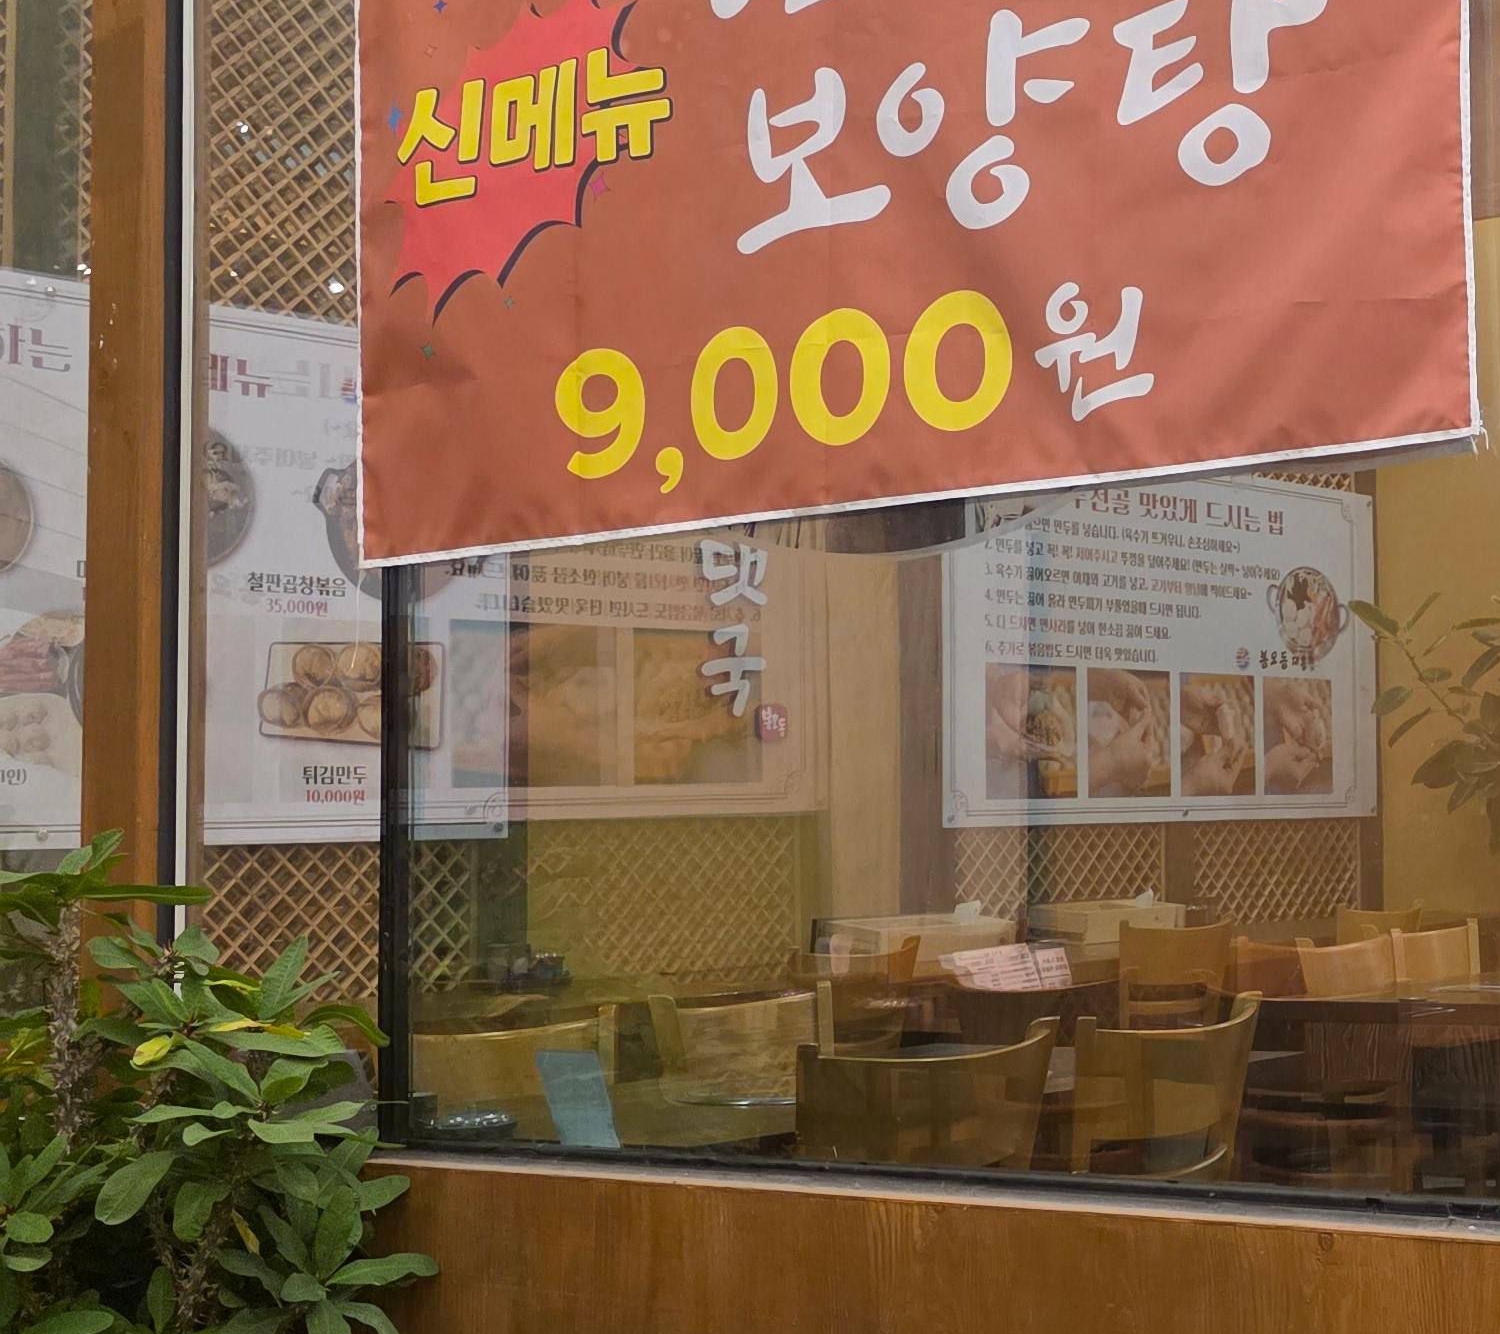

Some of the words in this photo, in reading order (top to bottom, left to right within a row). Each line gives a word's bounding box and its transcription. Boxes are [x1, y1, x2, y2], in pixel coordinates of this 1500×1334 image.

[396, 49, 672, 207] 신메뉴
[1138, 492, 1198, 524] 맛있게
[1205, 501, 1261, 533] 드시는
[1267, 510, 1284, 536] 법
[248, 572, 347, 597] 철판곱창볶음
[265, 598, 329, 618] 35,000원
[302, 765, 368, 785] 튀김만두
